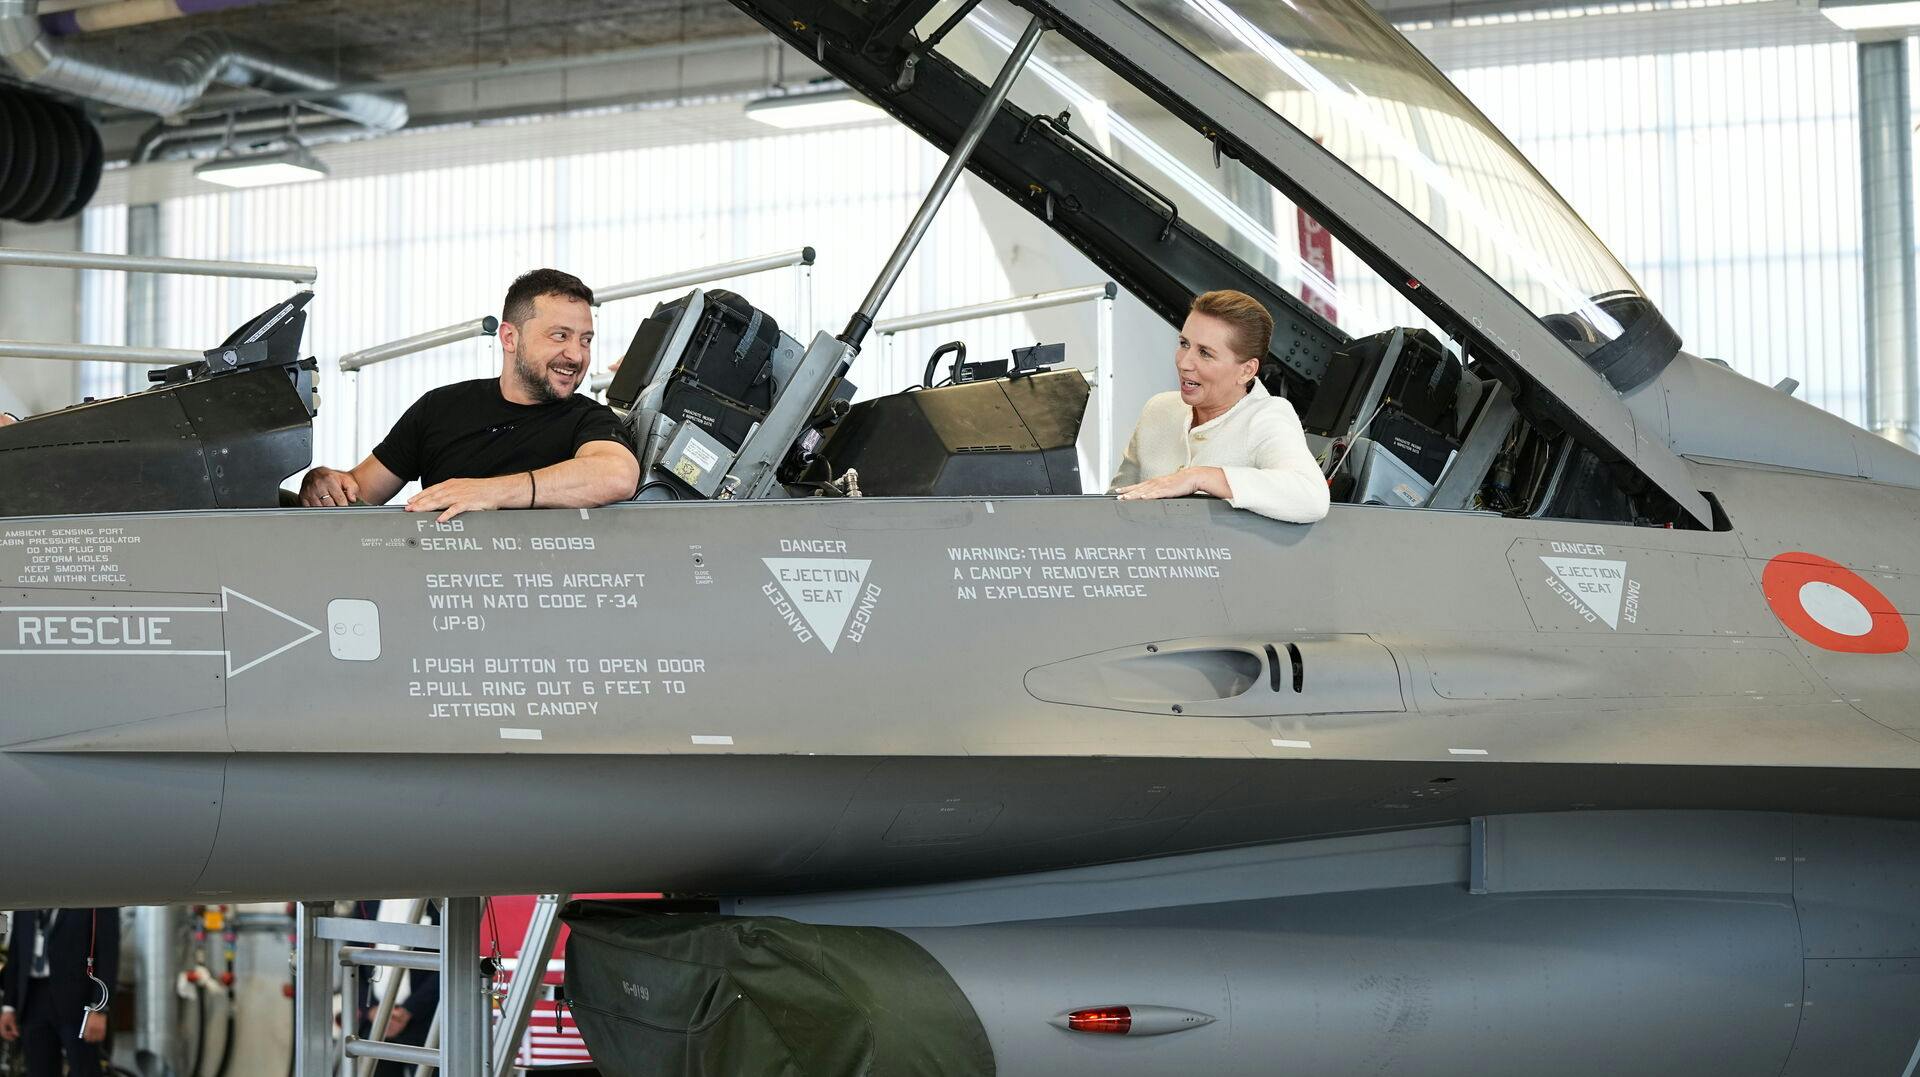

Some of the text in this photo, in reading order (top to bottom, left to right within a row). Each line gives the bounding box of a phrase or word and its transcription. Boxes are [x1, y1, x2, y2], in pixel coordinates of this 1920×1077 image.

[5, 529, 46, 537] AMBIENT
[51, 528, 94, 536] SENSING
[416, 519, 465, 532] F-16B
[29, 537, 81, 545] PRESSURE
[420, 537, 596, 551] SERIAL NO. 860199
[779, 539, 848, 553] DANGER
[1550, 541, 1606, 556] DANGER
[45, 546, 64, 554] NOT
[99, 545, 113, 553] OR
[1074, 547, 1146, 560] AIRCRAFT
[1155, 547, 1232, 561] CONTAINS
[24, 565, 51, 573] KEEP
[100, 564, 119, 572] AND
[779, 568, 860, 583] EJECTION
[953, 565, 1220, 580] A CANOPY REMOVER CONTAINING
[1556, 565, 1622, 579] EJECTION
[18, 575, 49, 583] CLEAN
[91, 574, 126, 582] CIRCLE
[425, 573, 646, 588] SERVICE THIS AIRCRAFT
[957, 584, 1148, 600] AN EXPLOSIVE CHARGE
[1578, 582, 1612, 594] SEAT
[428, 593, 638, 609] WITH NATO CODE F-34
[802, 589, 843, 603] SEAT
[1545, 576, 1597, 623] DANGER
[1624, 579, 1641, 624] DANGER
[762, 581, 813, 643] DANGER
[847, 582, 882, 643] DANGER
[18, 616, 172, 645] RESCUE
[432, 615, 486, 632] (JP-8)
[484, 658, 556, 674] BUTTON
[565, 658, 590, 674] TO
[599, 658, 648, 673] OPEN
[657, 658, 706, 673] DOOR
[482, 681, 527, 697] RING
[536, 680, 572, 696] OUT
[582, 681, 595, 695] 6
[604, 680, 652, 695] FEET
[661, 680, 686, 694] TO
[428, 701, 599, 718] JETTISON CANOPY
